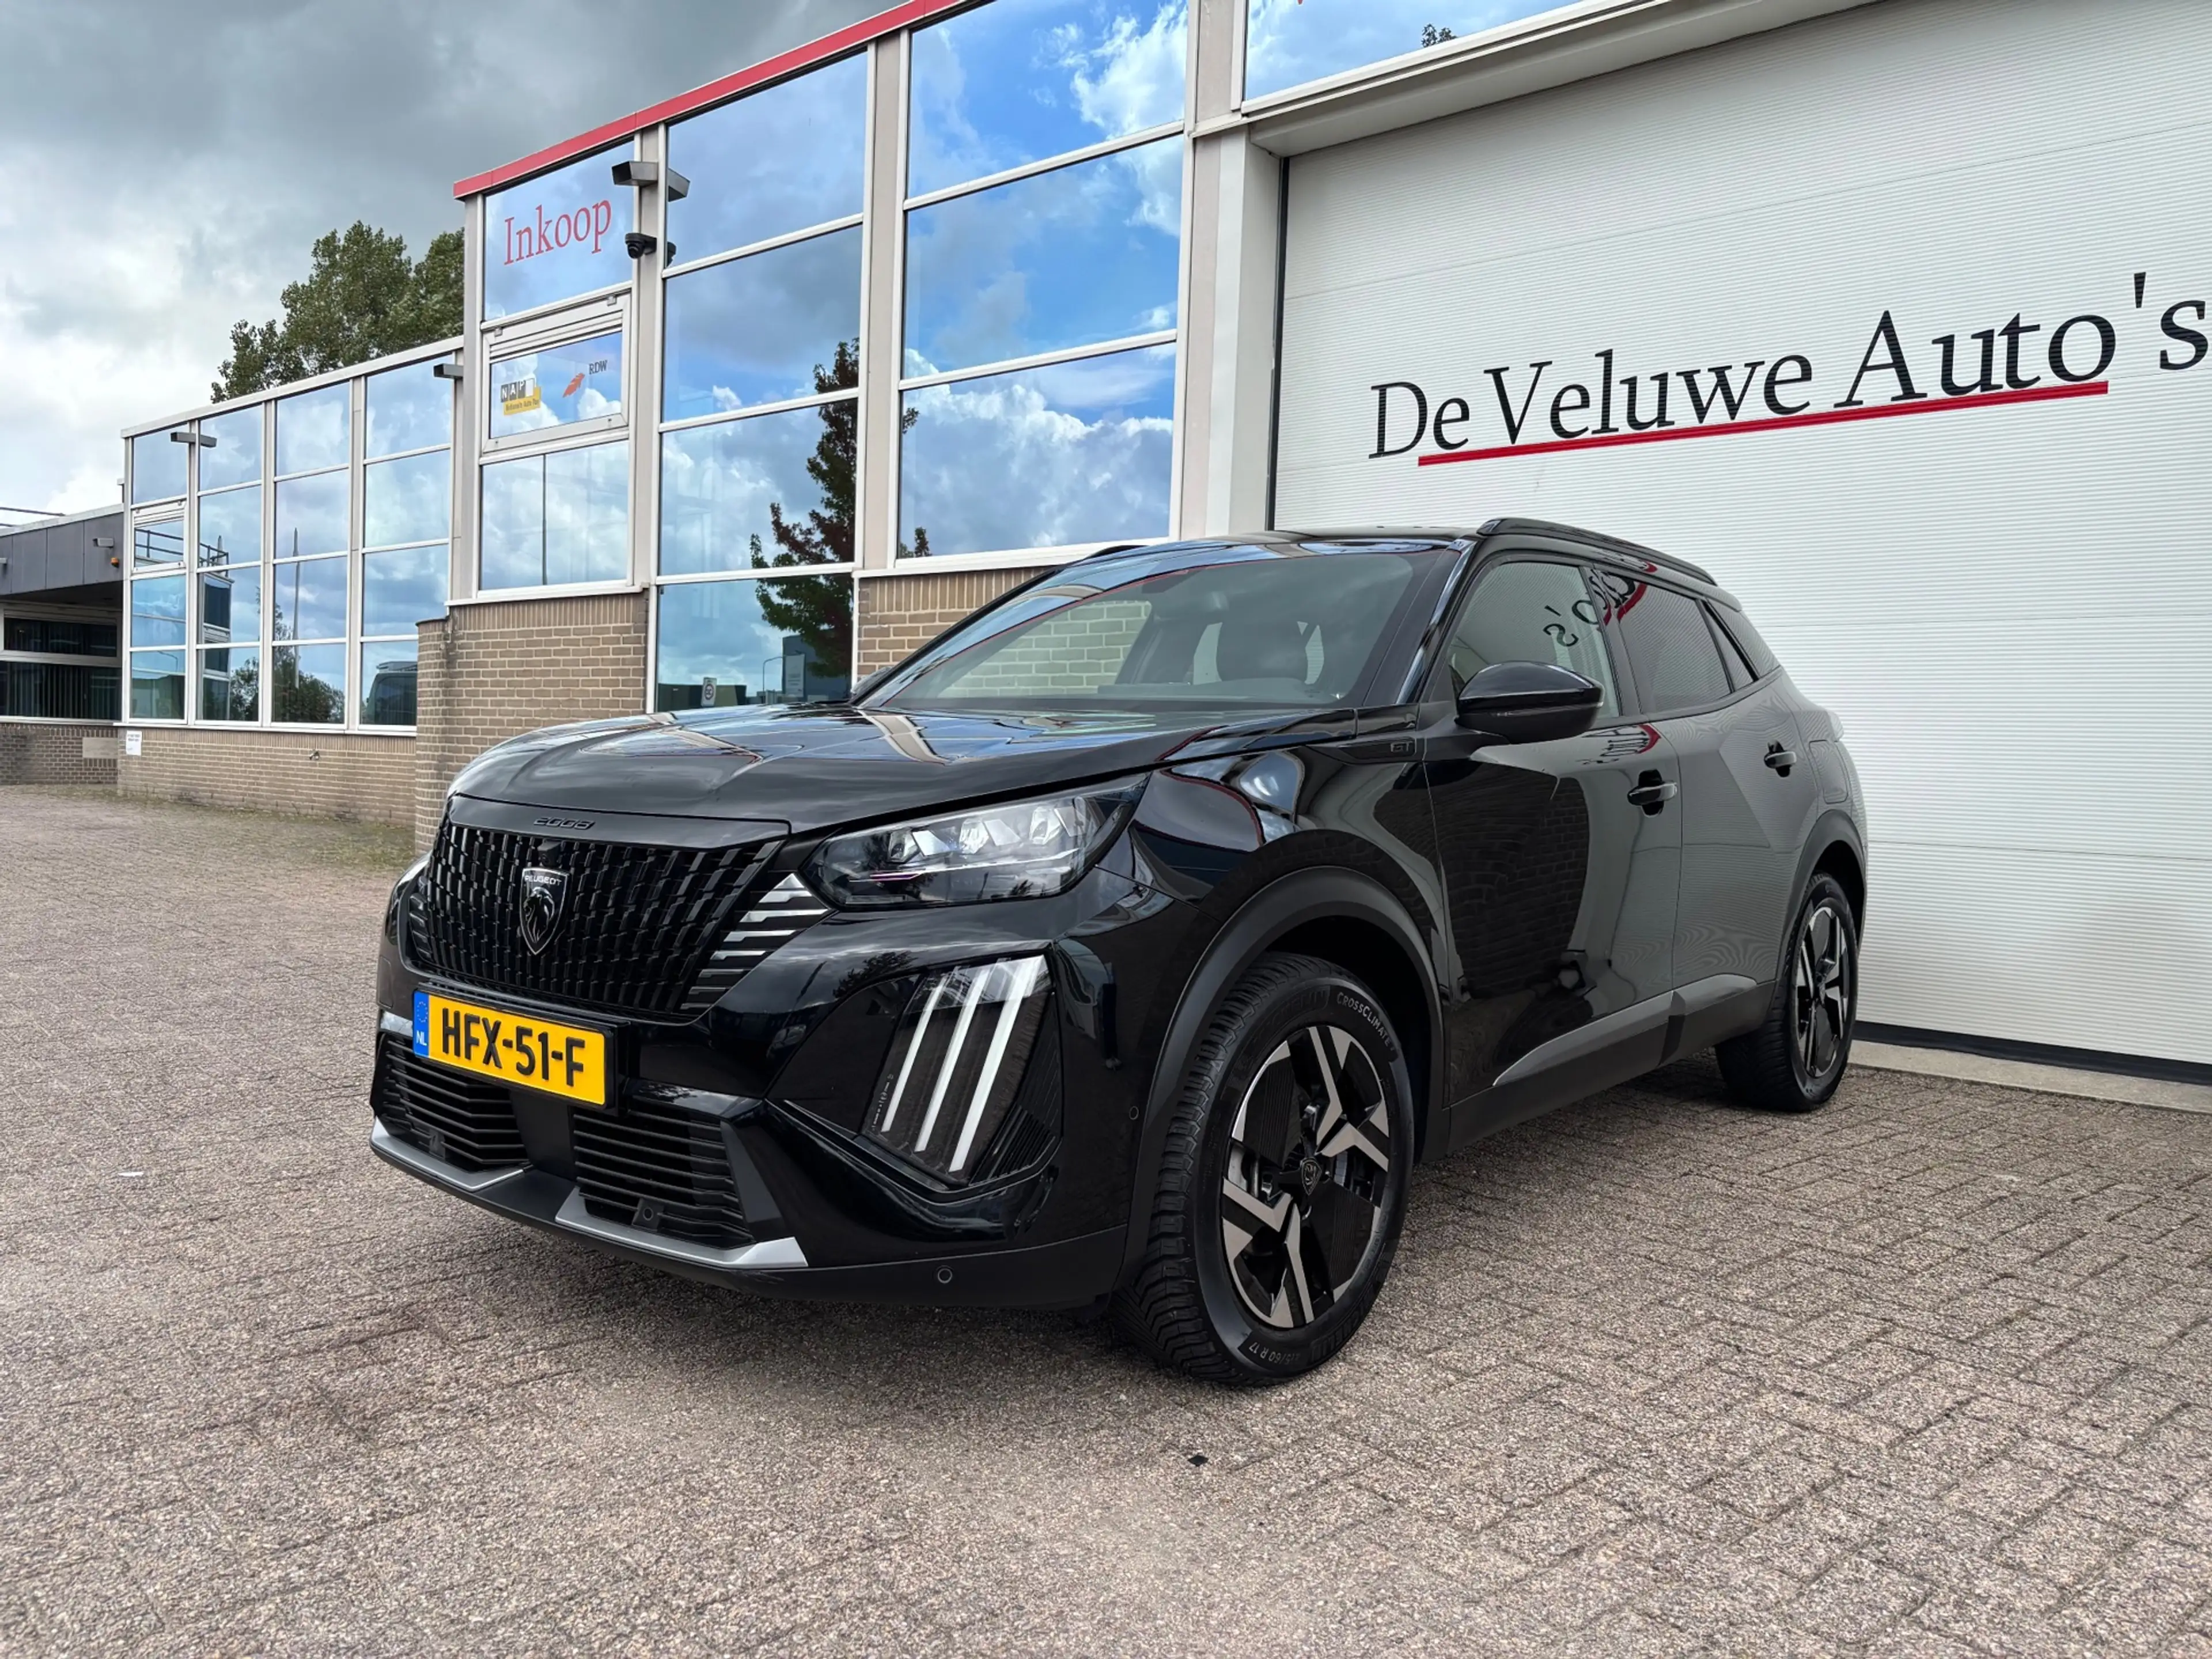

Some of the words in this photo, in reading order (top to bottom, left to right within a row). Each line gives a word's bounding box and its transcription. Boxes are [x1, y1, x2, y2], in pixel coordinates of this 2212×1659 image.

[504, 199, 611, 265] Inkoop
[589, 359, 608, 374] RDW
[1369, 381, 1469, 459] De
[1483, 349, 1812, 445] Veluwe
[1834, 272, 2209, 408] Auto's
[502, 380, 525, 400] NAP
[1391, 741, 1413, 752] GT
[533, 817, 596, 830] 2008
[524, 876, 562, 885] PEUGEOT
[416, 1031, 427, 1046] NL
[442, 1008, 585, 1086] HFX-51-F
[1248, 1342, 1260, 1354] 17
[1260, 1347, 1269, 1359] R
